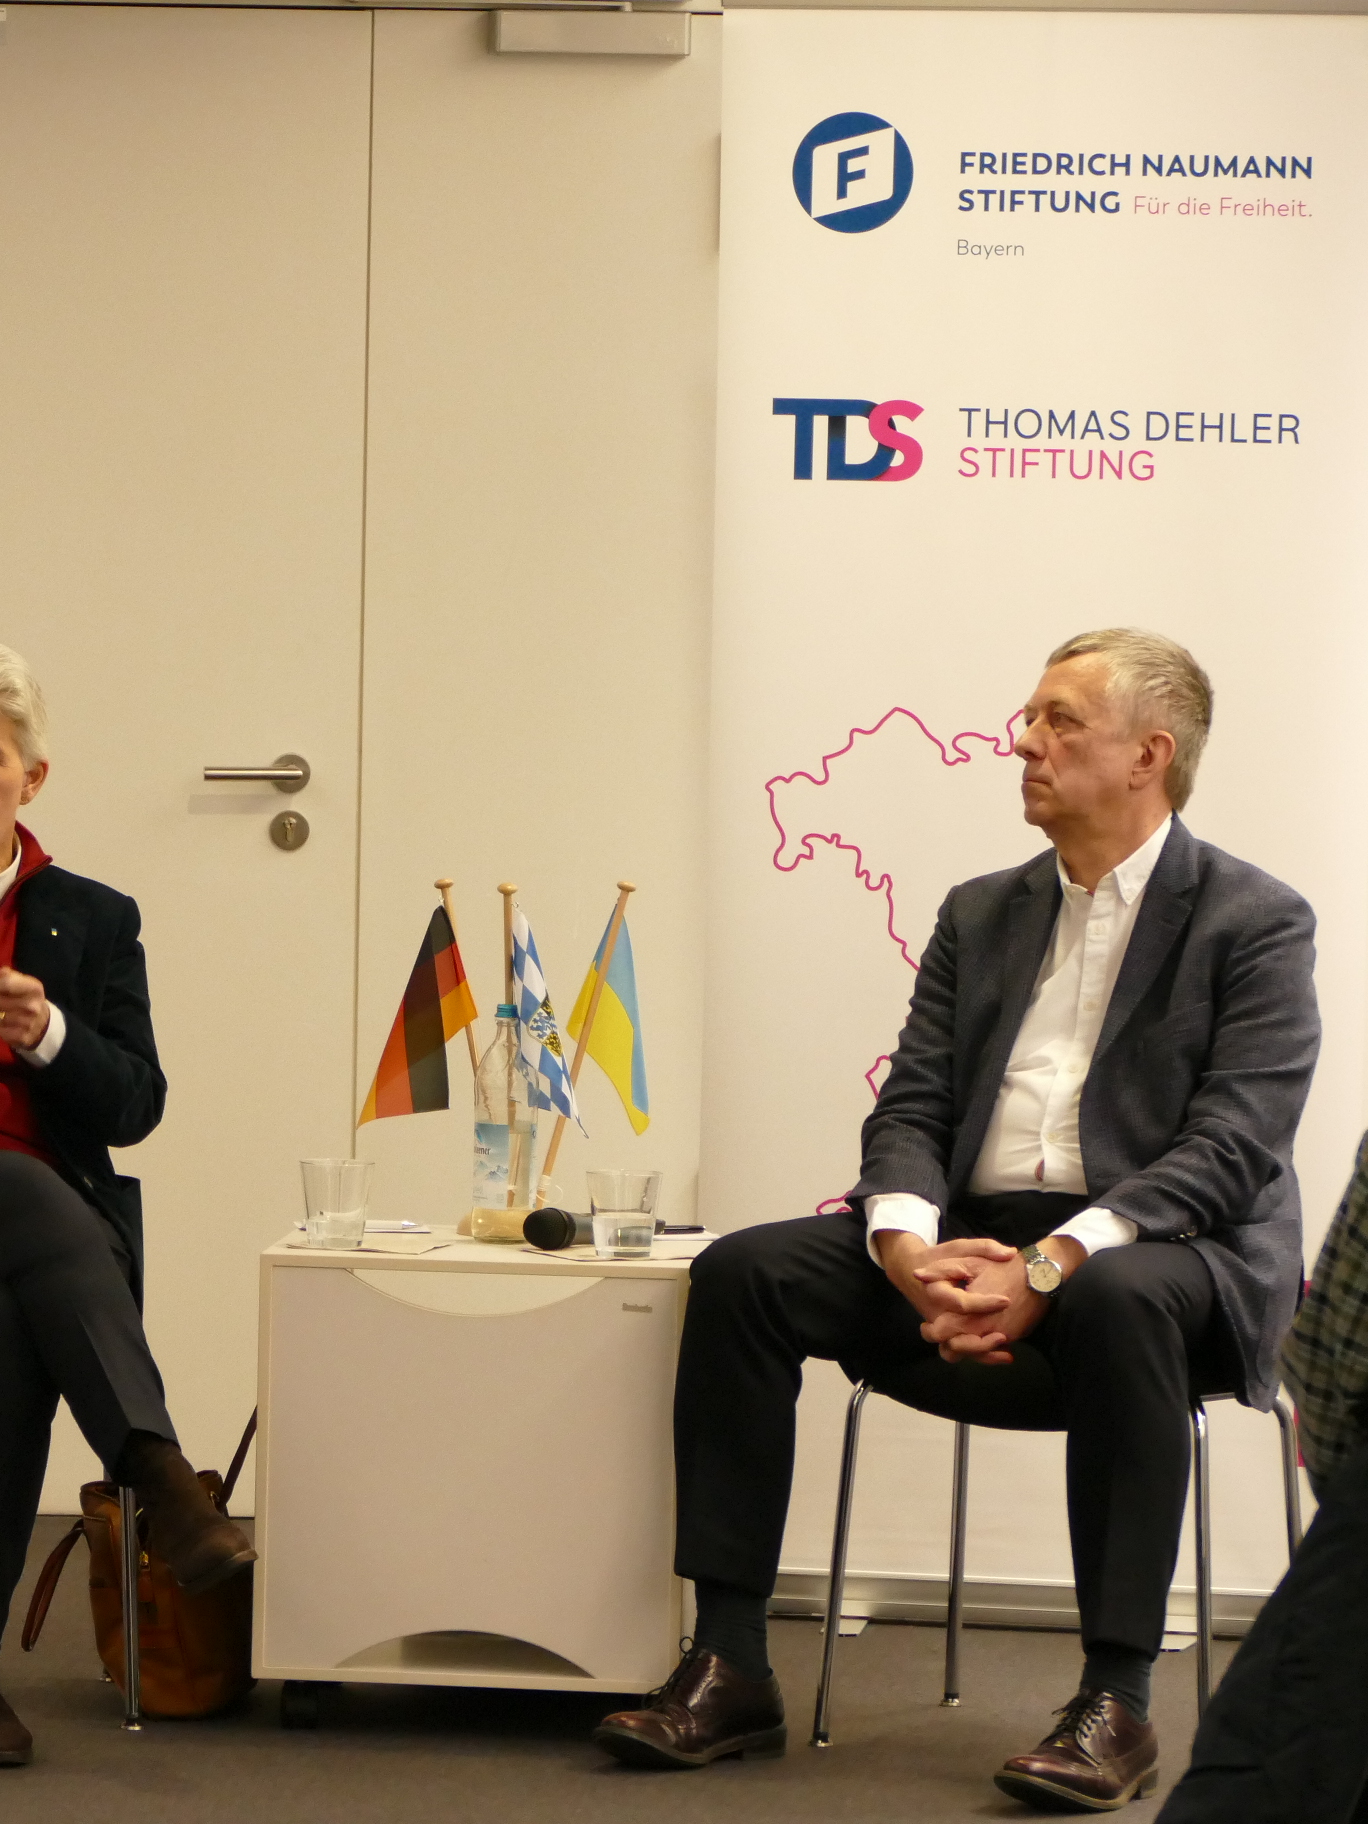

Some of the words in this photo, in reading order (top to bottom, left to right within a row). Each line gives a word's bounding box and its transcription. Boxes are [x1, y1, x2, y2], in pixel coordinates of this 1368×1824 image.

[959, 151, 1131, 177] FRIEDRICH
[1141, 153, 1313, 180] NAUMANN
[957, 188, 1121, 214] STIFTUNG
[1133, 195, 1171, 216] Für
[1177, 196, 1212, 217] die
[1219, 196, 1313, 218] Freiheit.
[956, 238, 1025, 260] Bayern
[772, 397, 925, 482] TDS
[958, 407, 1131, 442] THOMAS
[1145, 410, 1300, 445] DEHLER
[957, 446, 1155, 482] STIFTUNG
